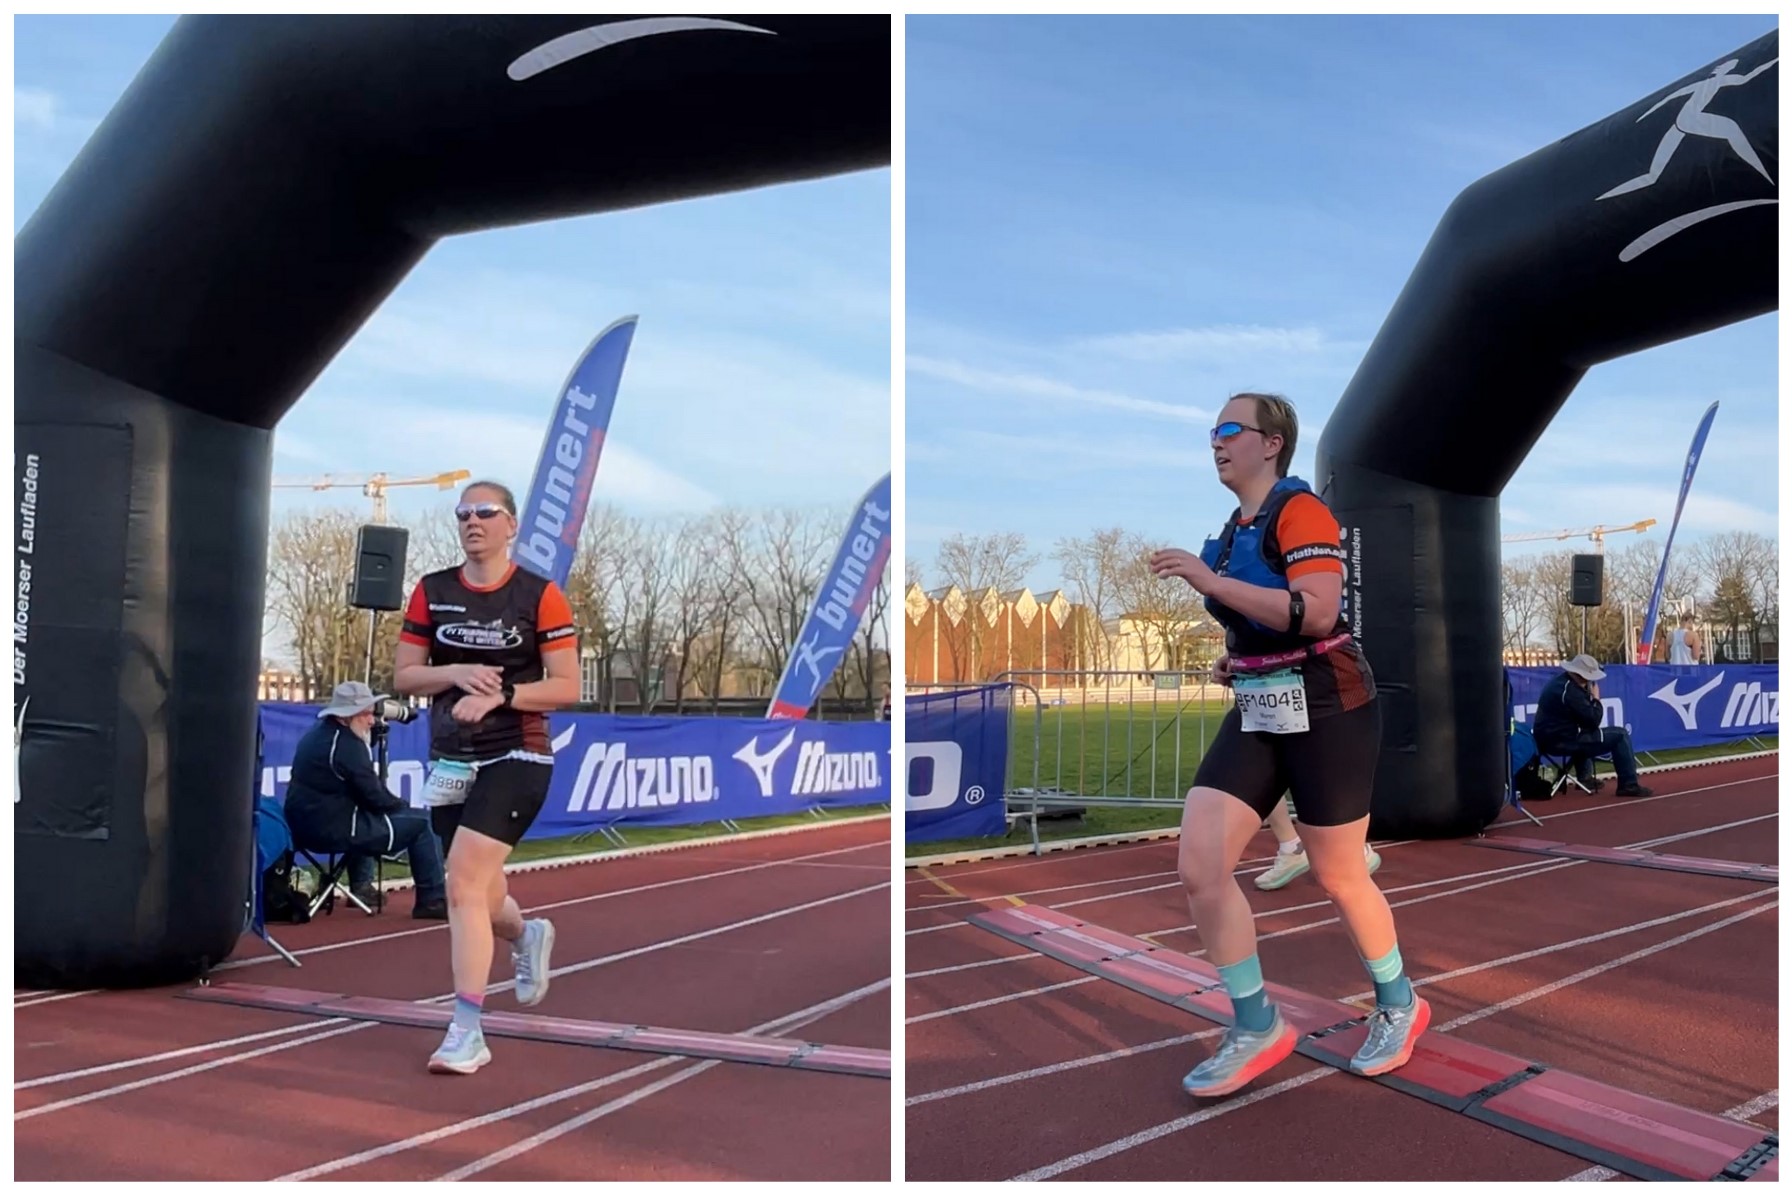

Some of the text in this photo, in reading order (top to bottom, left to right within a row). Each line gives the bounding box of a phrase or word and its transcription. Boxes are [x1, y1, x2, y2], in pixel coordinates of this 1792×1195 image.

[518, 385, 596, 571] bunert
[14, 453, 39, 685] Der Moerser Laufladen
[816, 499, 891, 632] bunert
[1351, 528, 1362, 587] Laufladen
[1352, 589, 1362, 639] Moerser
